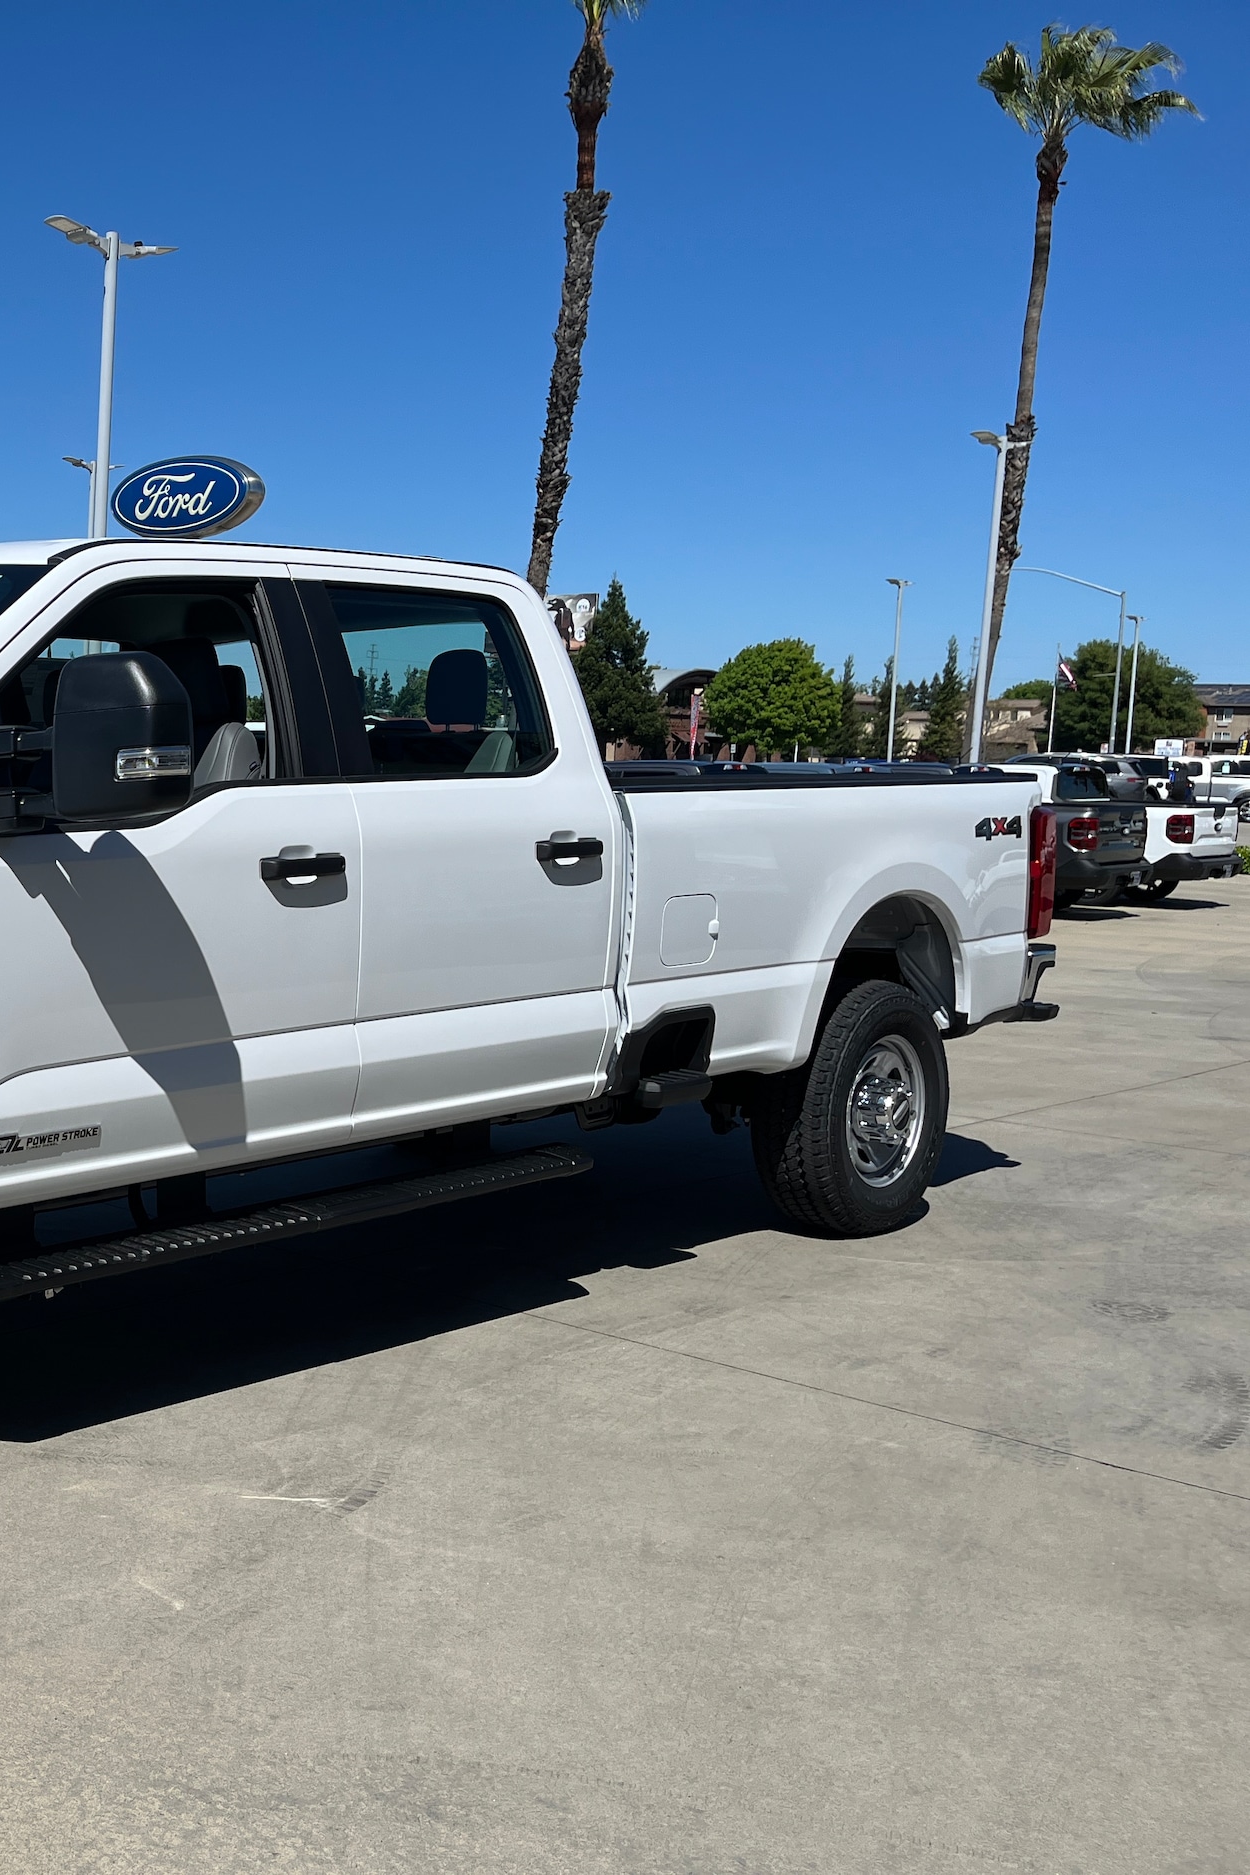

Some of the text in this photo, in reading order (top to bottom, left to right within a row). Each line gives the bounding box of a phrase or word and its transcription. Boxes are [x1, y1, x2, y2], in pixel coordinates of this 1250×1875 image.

[135, 473, 216, 521] Ford
[26, 1133, 60, 1147] POWER
[61, 1127, 99, 1141] STROKE
